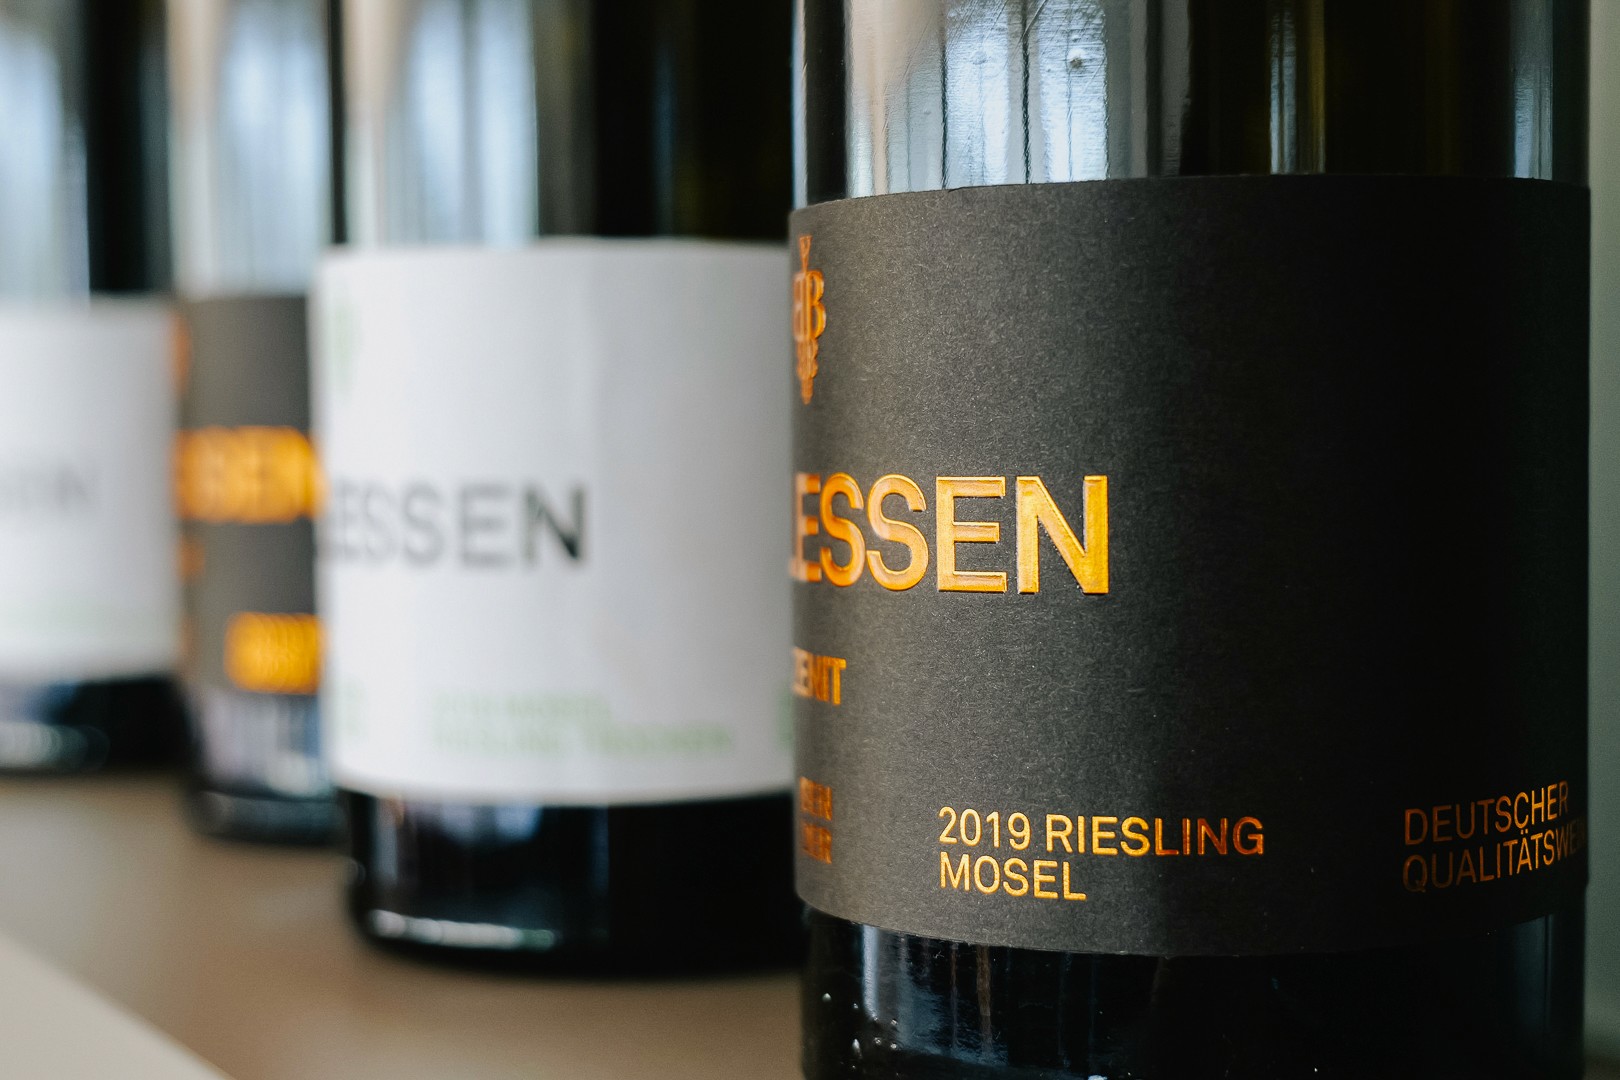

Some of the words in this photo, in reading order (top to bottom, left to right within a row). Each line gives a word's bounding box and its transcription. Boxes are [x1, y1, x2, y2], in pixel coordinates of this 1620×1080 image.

[328, 480, 589, 569] ESSEN
[790, 472, 1110, 595] ESSEN
[937, 805, 1032, 851] 2019
[1045, 813, 1265, 858] RIESLING
[1403, 778, 1570, 847] DEUTSCHER
[939, 851, 1088, 901] MOSEL
